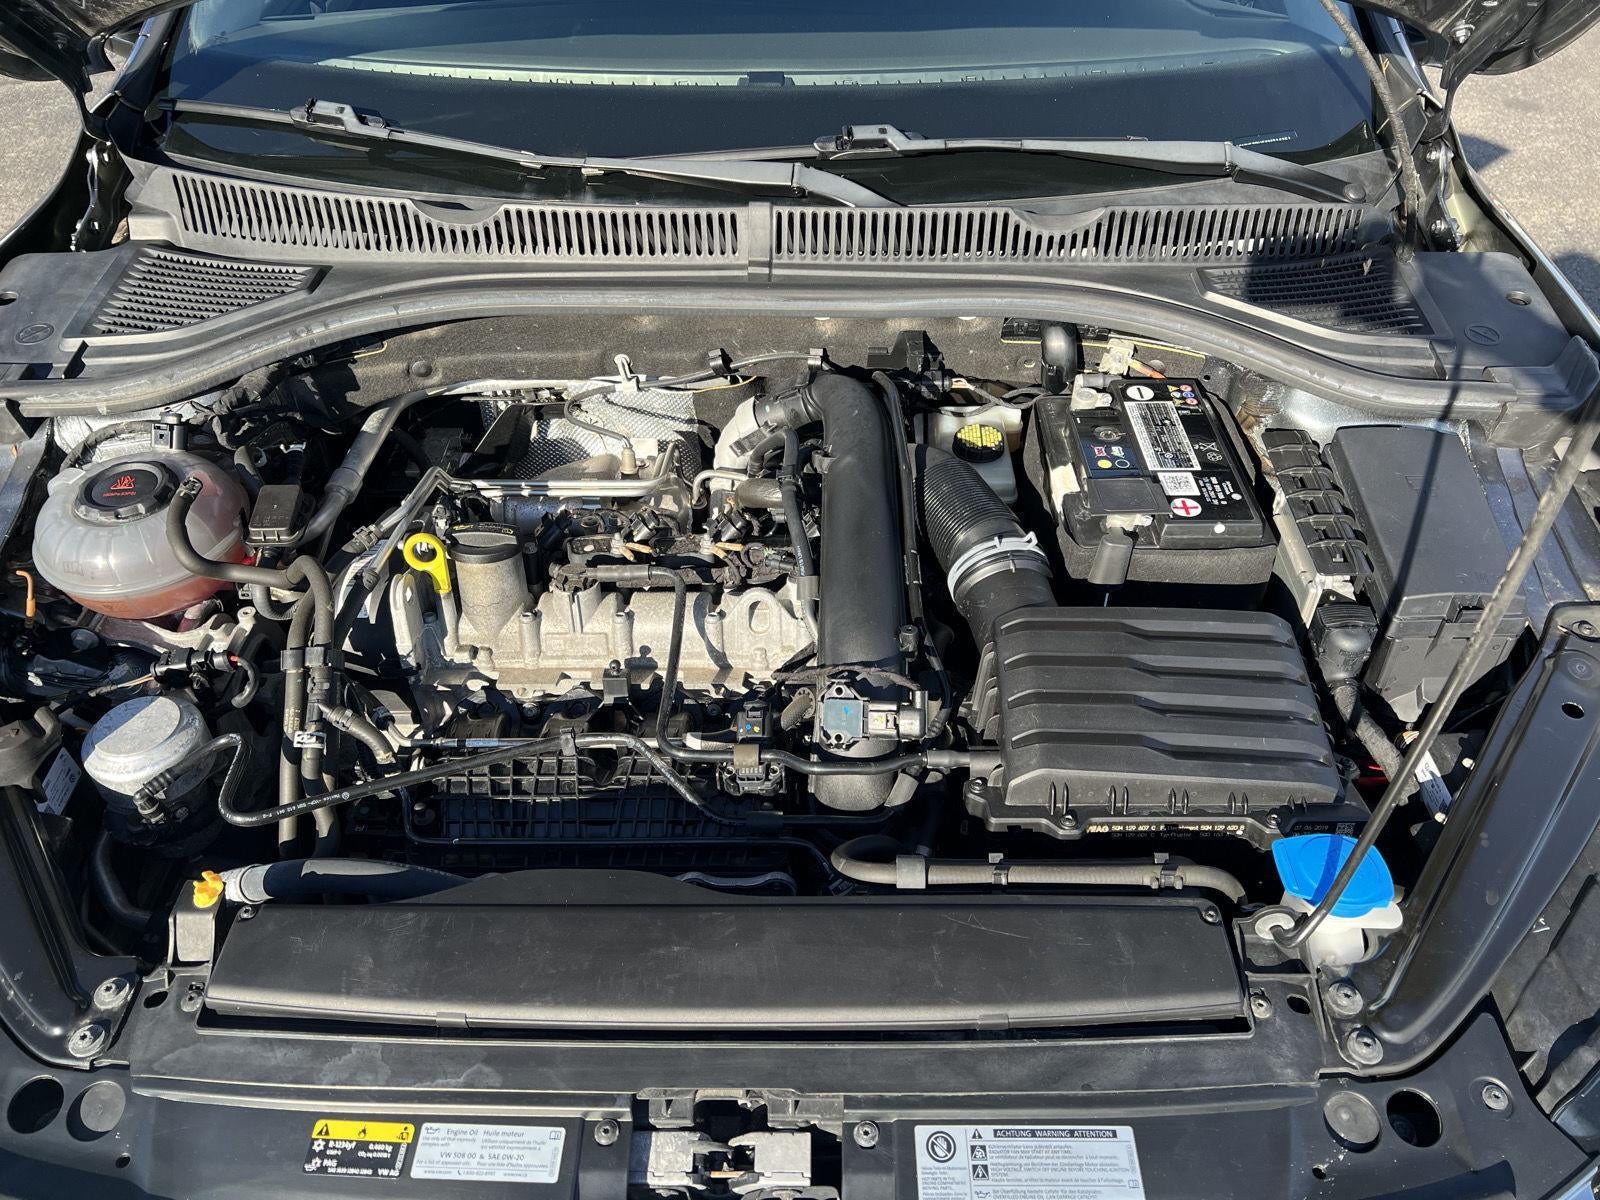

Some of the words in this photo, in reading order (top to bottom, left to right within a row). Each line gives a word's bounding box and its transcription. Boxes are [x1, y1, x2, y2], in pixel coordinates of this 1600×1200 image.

[446, 1128, 468, 1136] Engine
[501, 1130, 525, 1138] moteur
[440, 1151, 452, 1159] VW
[453, 1151, 466, 1159] 508
[467, 1152, 477, 1160] 00
[322, 1158, 338, 1167] PAG
[377, 1168, 389, 1176] VW
[389, 1169, 400, 1177] AG
